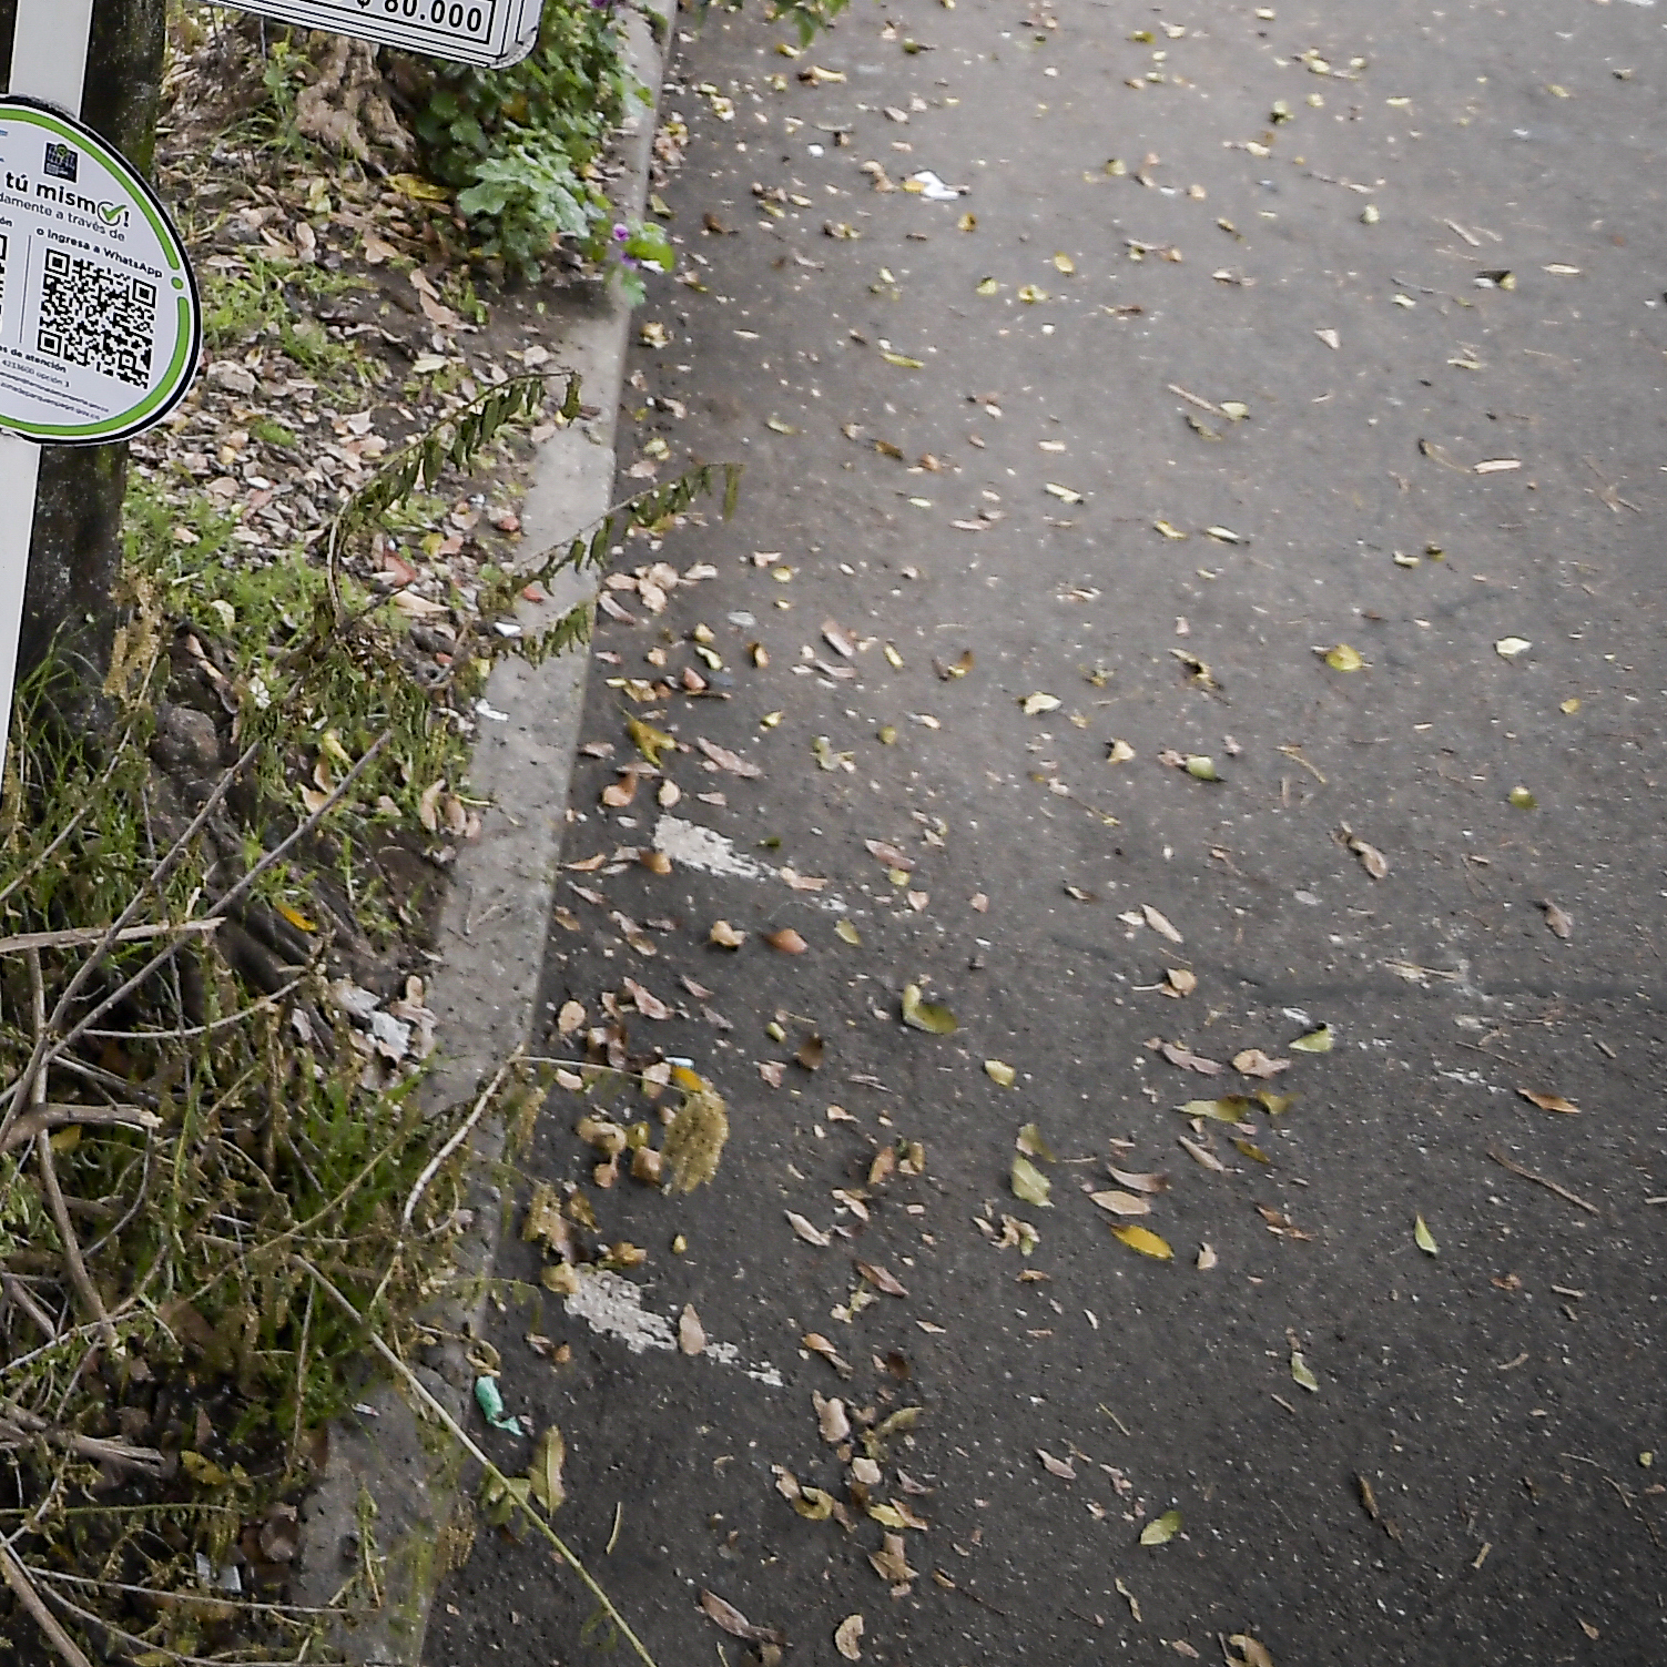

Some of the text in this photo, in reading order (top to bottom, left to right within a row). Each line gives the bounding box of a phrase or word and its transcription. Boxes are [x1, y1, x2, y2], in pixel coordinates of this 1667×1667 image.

[5, 170, 28, 193] tú
[55, 211, 63, 220] a
[66, 212, 106, 235] través
[108, 228, 125, 243] de
[36, 227, 44, 237] o
[93, 245, 101, 254] a
[103, 246, 163, 279] WhatsApp
